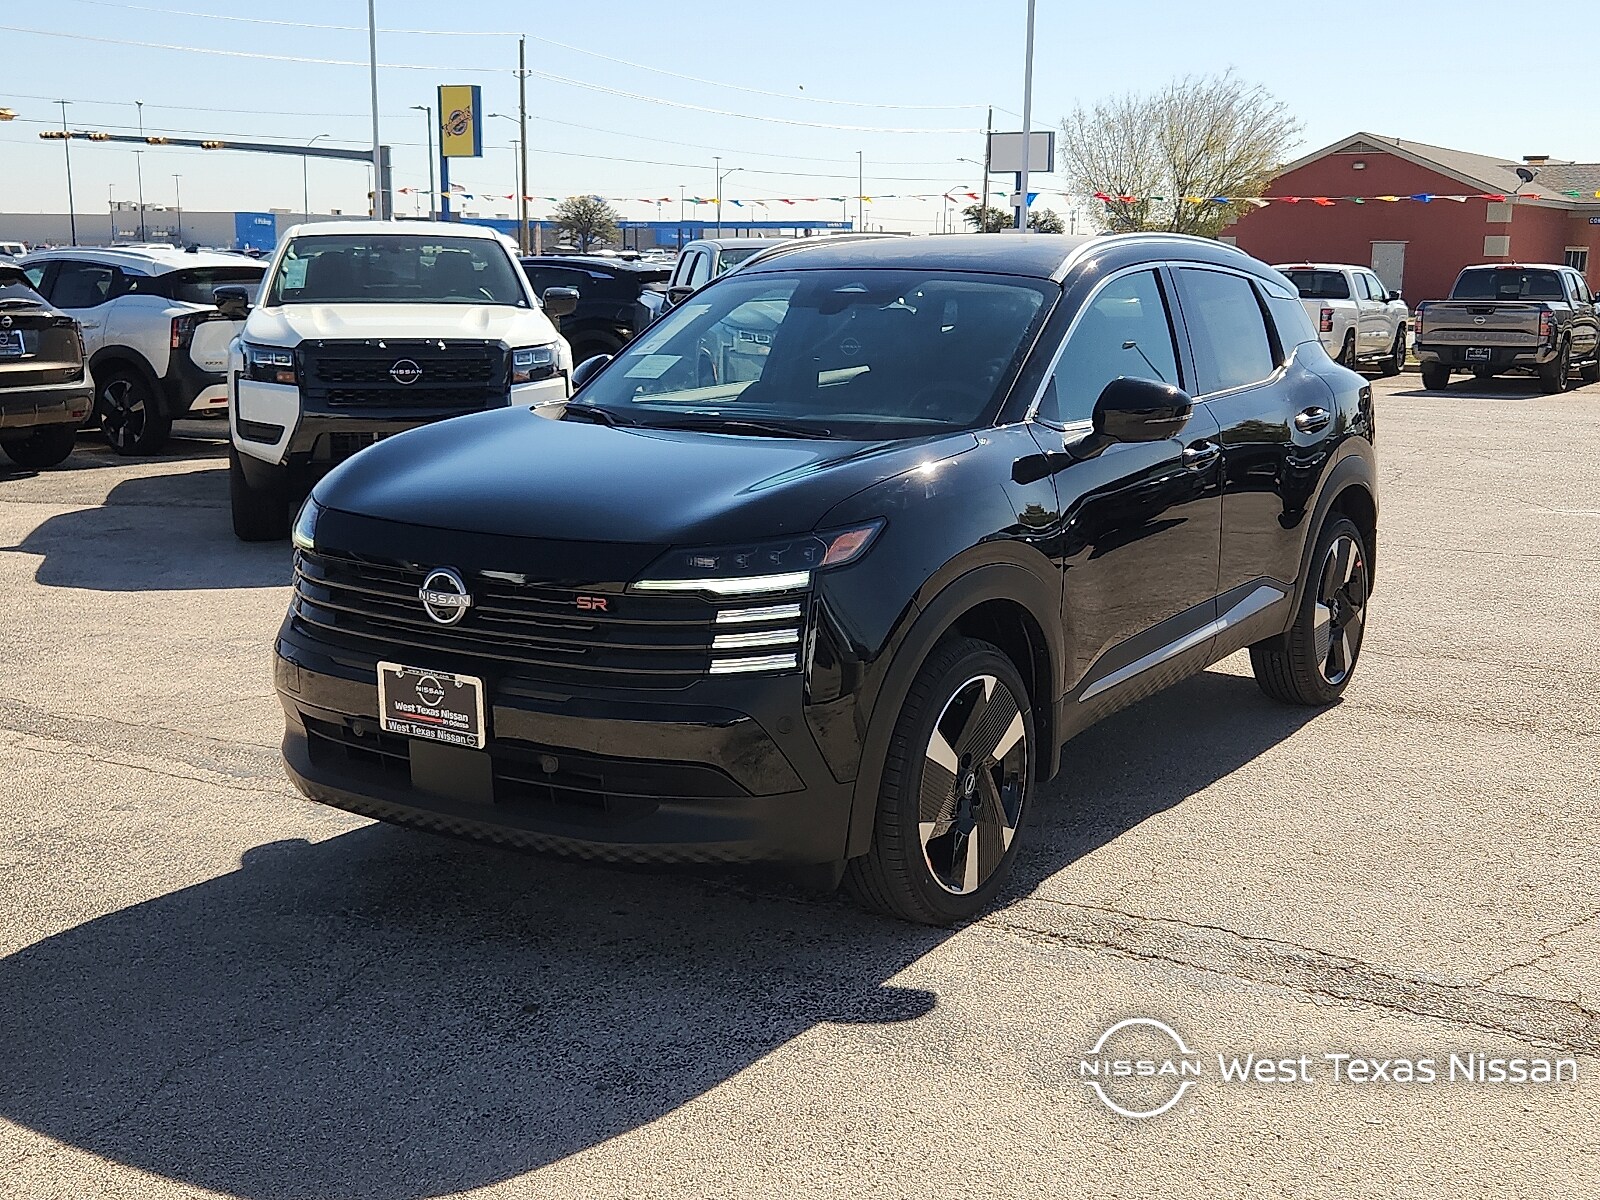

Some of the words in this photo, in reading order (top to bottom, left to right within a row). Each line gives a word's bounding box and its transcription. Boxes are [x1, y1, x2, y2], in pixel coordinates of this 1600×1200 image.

[419, 589, 470, 606] NISSAN
[576, 596, 608, 611] SR
[415, 685, 445, 696] NISSAN
[394, 701, 416, 713] West
[415, 704, 440, 717] Texas
[440, 709, 469, 722] Nissan
[388, 720, 411, 733] West
[411, 726, 436, 738] Texas
[437, 730, 467, 743] Nissan
